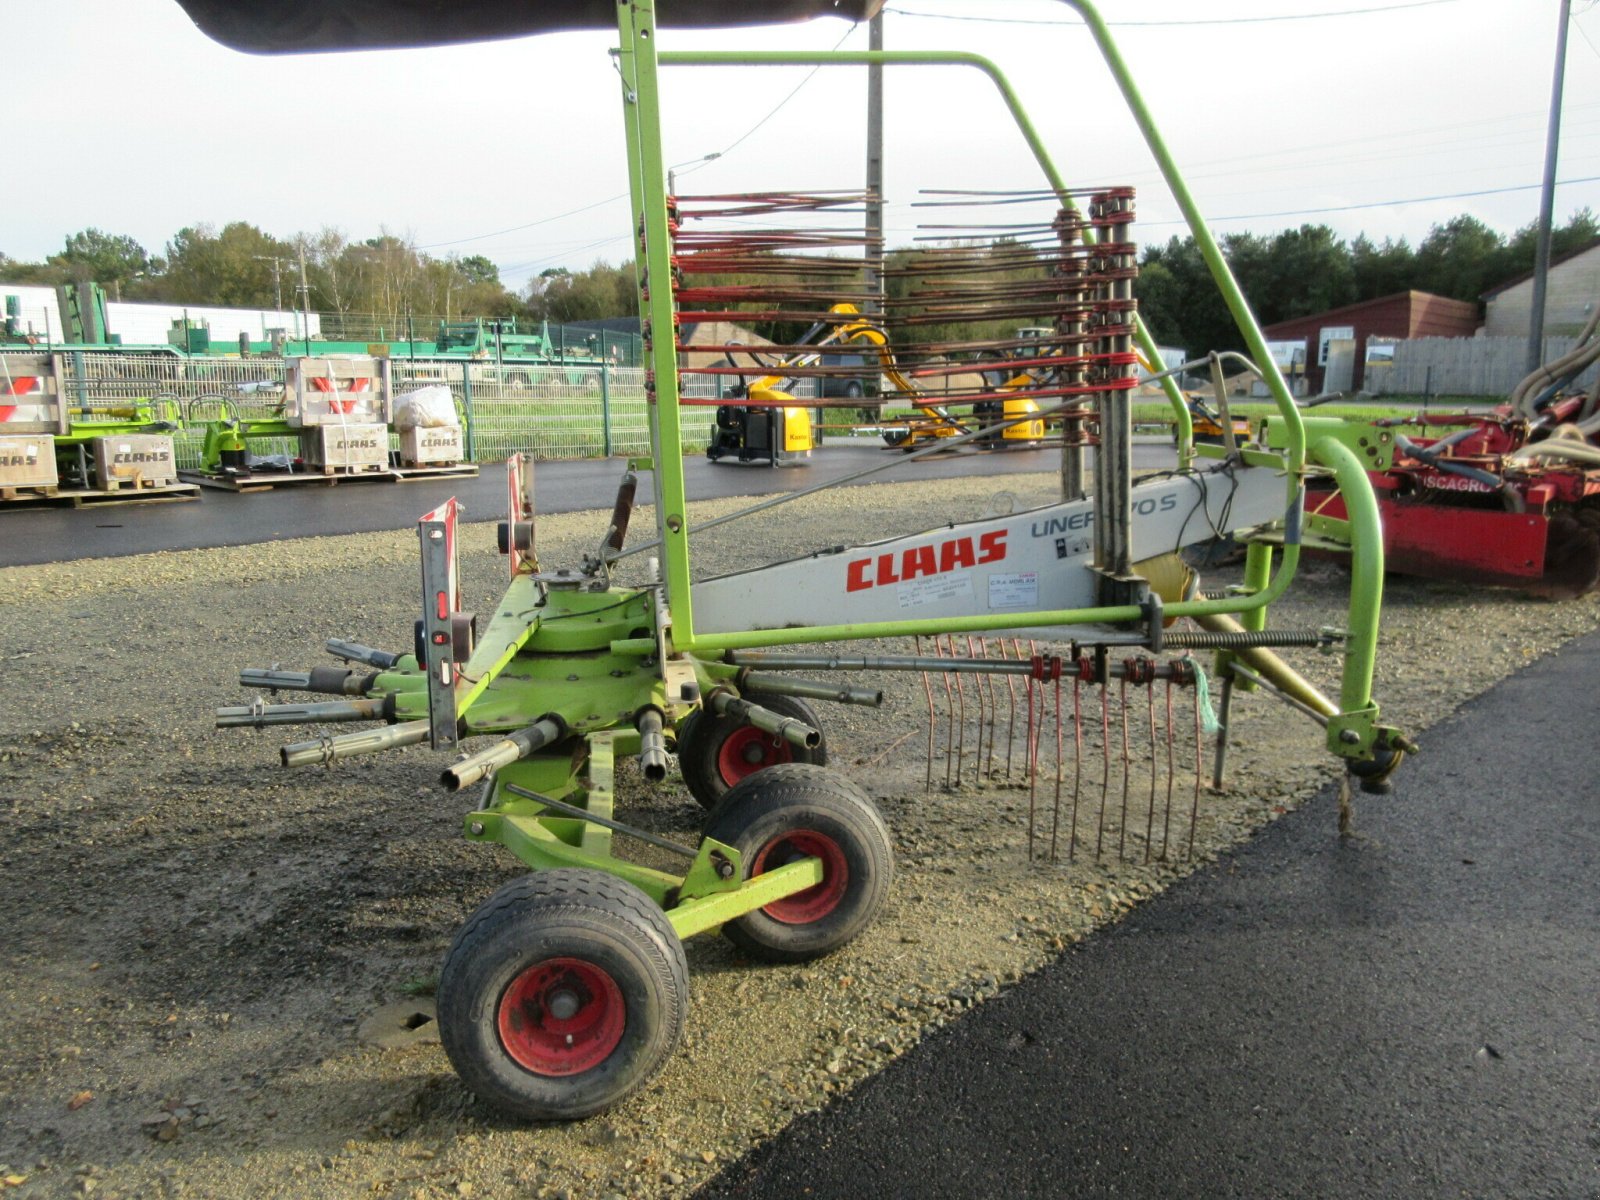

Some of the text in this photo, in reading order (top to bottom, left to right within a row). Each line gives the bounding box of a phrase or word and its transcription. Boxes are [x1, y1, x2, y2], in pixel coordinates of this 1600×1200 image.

[420, 437, 458, 448] CLAAS
[113, 451, 169, 464] CLAAS
[1159, 493, 1177, 512] S
[846, 528, 1008, 592] CLAAS
